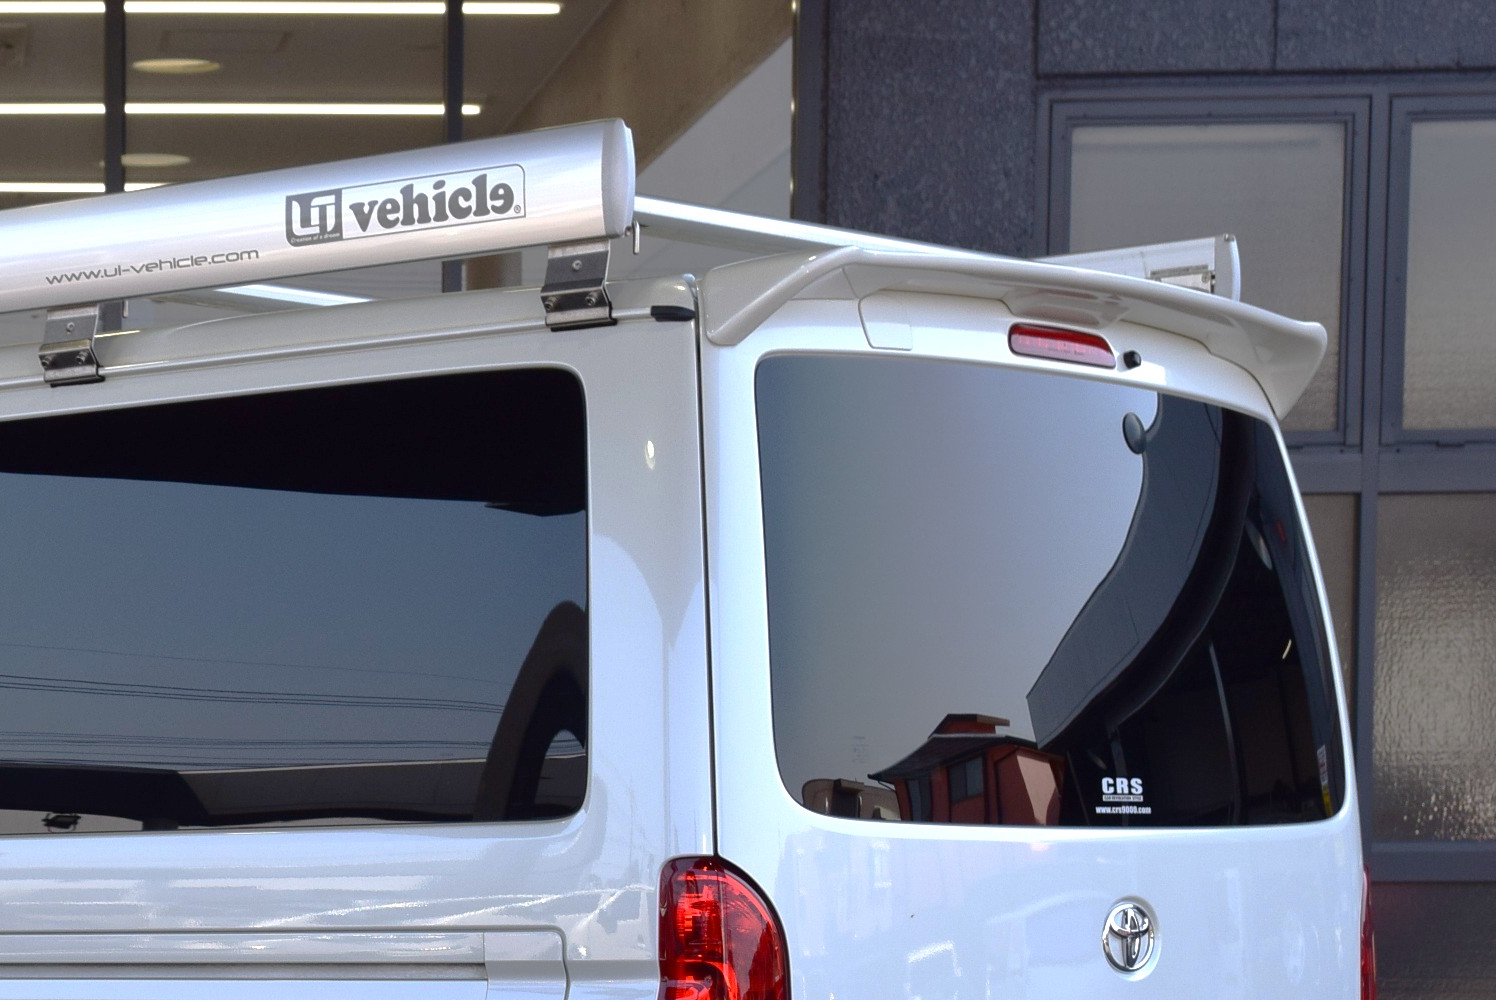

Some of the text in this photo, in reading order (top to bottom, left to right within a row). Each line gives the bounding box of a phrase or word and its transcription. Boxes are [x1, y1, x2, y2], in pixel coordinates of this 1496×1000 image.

[349, 173, 515, 232] vehicle
[1101, 776, 1144, 795] CRS
[1095, 805, 1152, 815] www.crs9000.com
